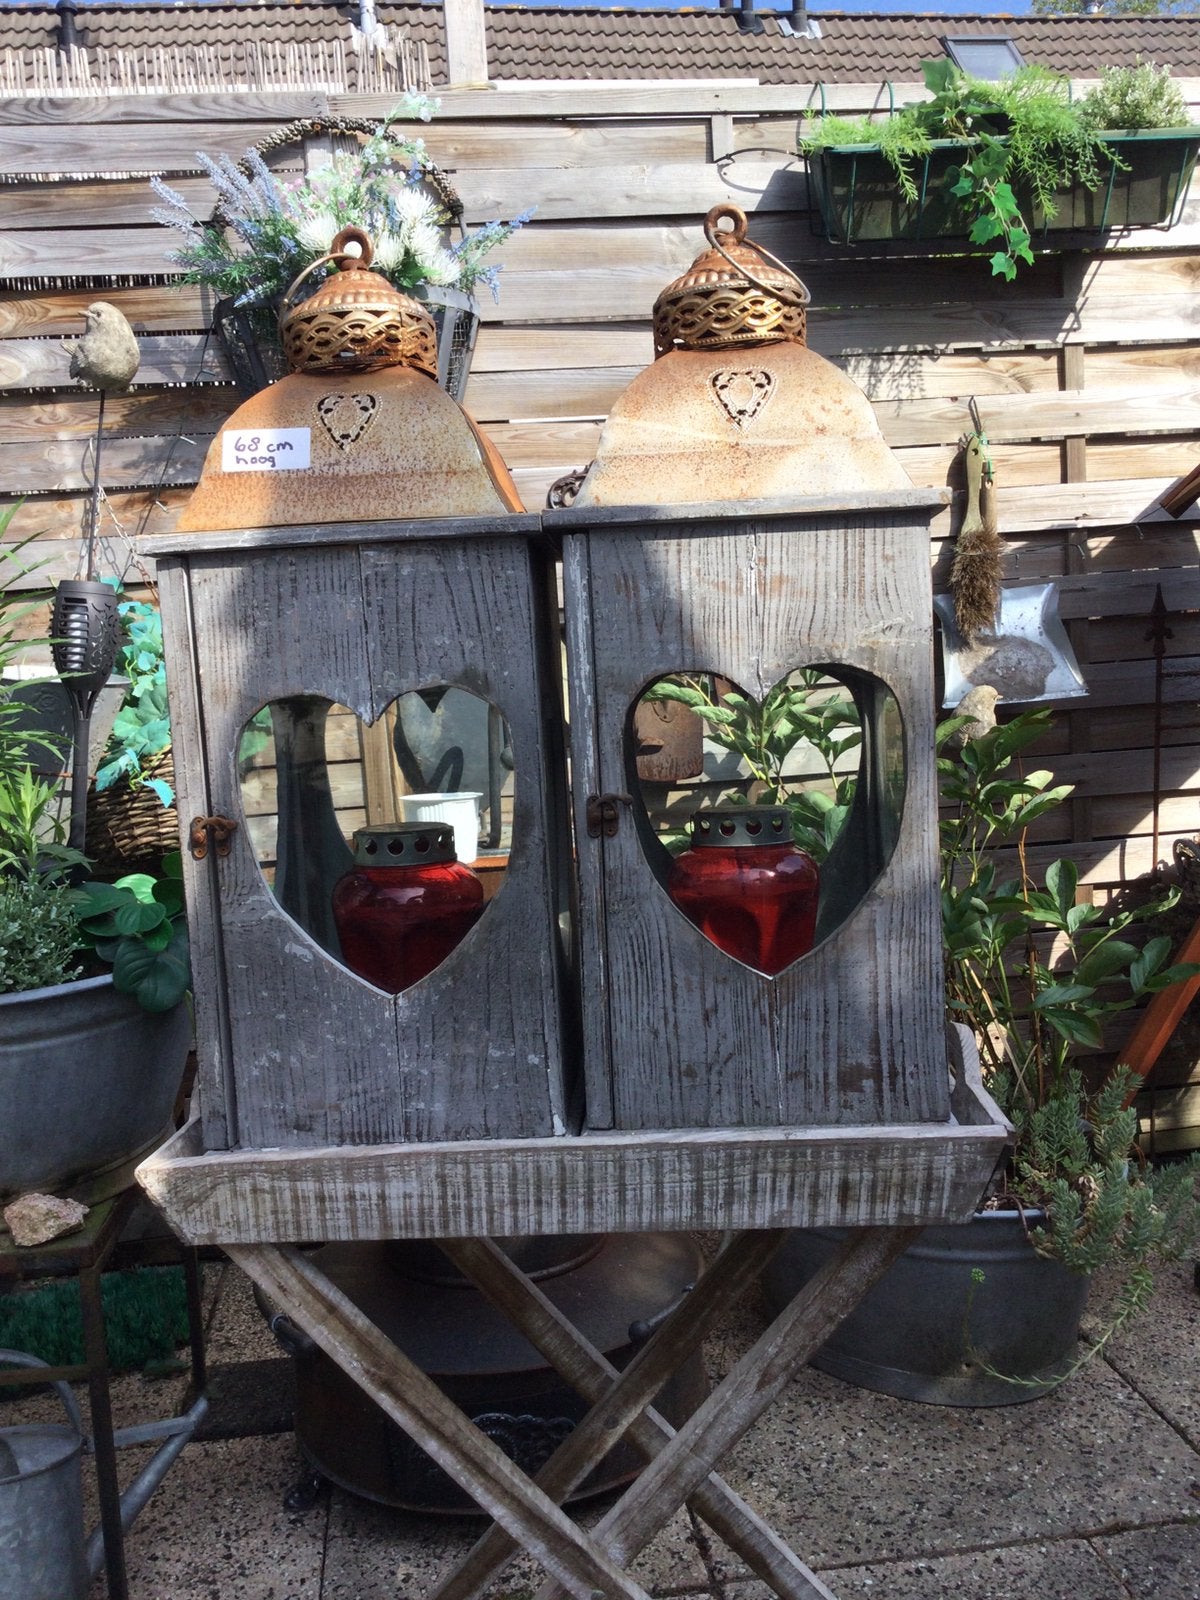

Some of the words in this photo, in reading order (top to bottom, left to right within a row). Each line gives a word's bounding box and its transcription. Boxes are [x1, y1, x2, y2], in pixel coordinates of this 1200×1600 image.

[234, 436, 261, 452] 68
[266, 441, 294, 453] cm
[235, 455, 276, 468] hoog
